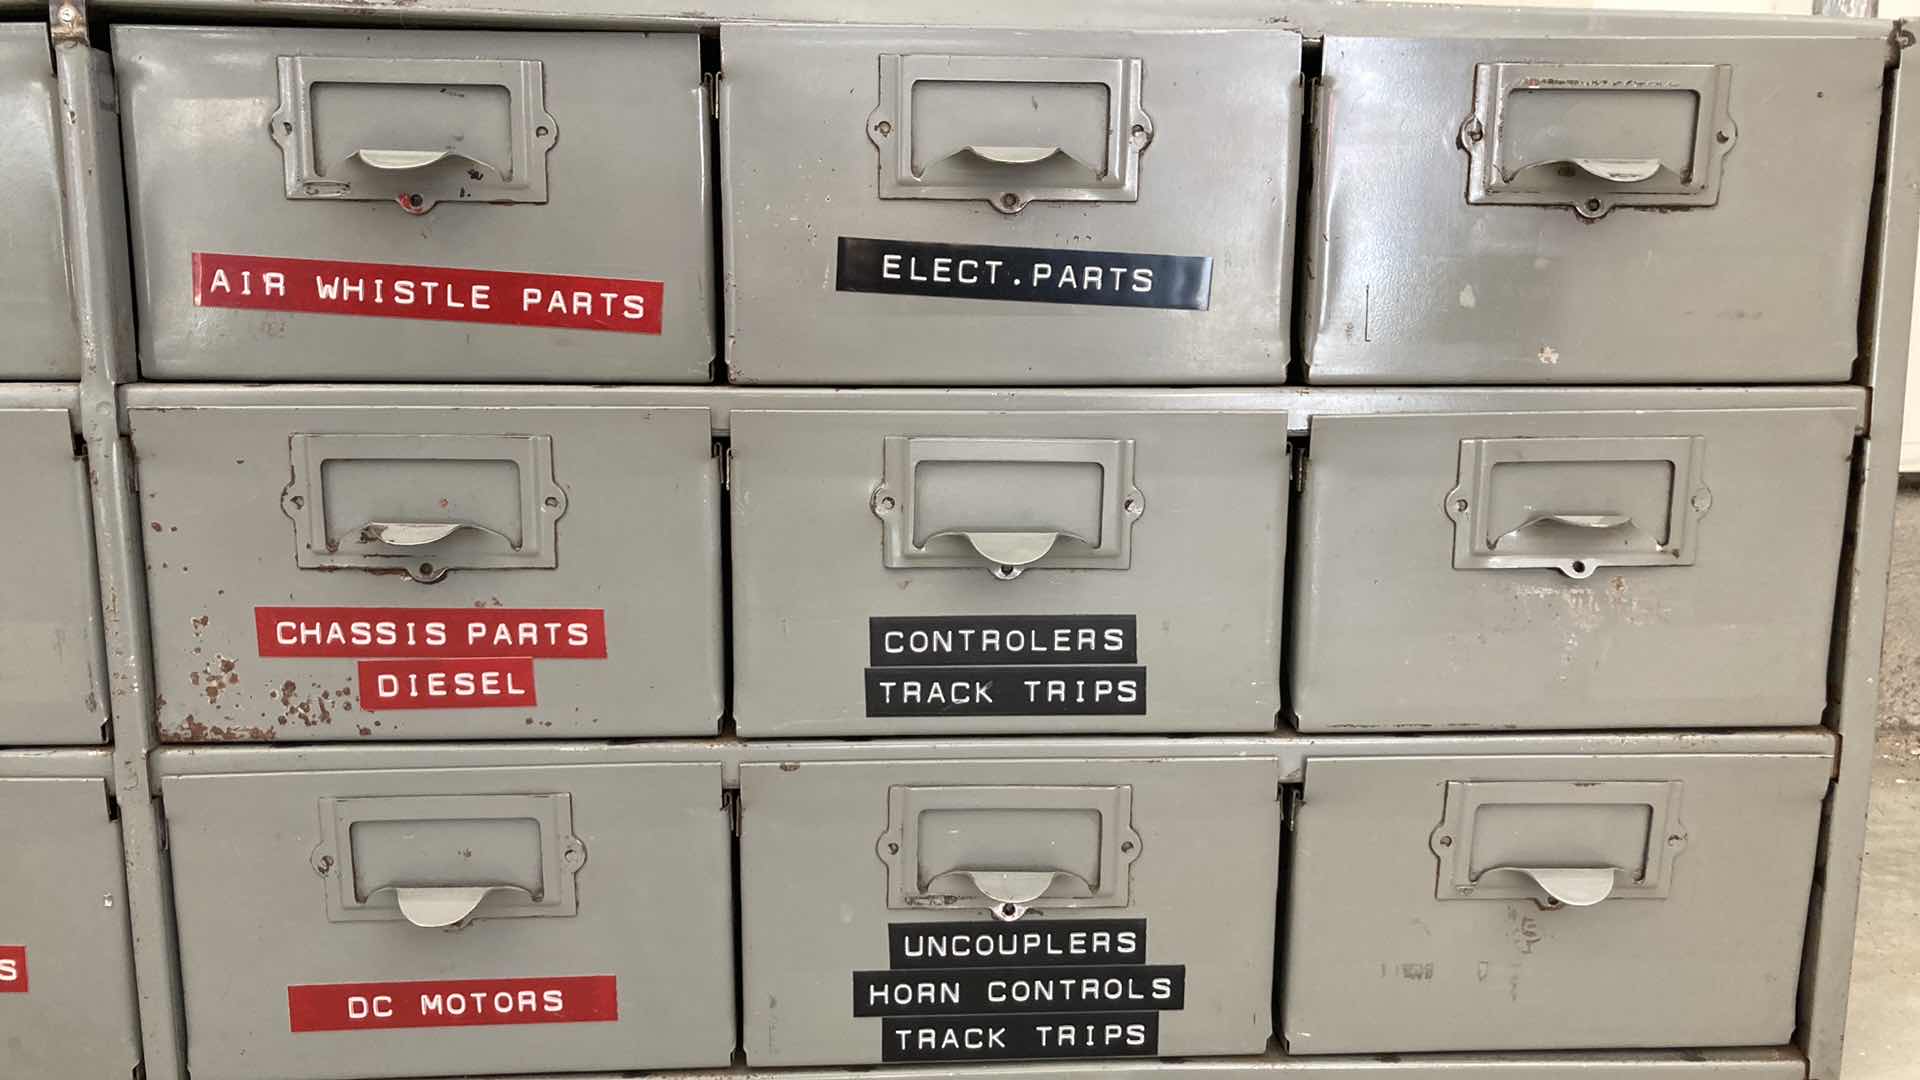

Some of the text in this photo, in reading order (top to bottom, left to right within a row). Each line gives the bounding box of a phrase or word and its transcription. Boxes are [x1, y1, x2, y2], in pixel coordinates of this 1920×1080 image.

[210, 268, 646, 319] AIR WHISTLE PARTS
[276, 622, 589, 646] CHASSIS PARTS
[884, 629, 1125, 655] CONTROLERS
[377, 671, 526, 698] DIESEL
[879, 680, 1138, 705] TRACK TRIPS
[904, 931, 1138, 957] UNCOUPLERS
[348, 990, 564, 1019] DC MOTORS
[869, 977, 1171, 1006] HORN CONTROLS
[895, 1025, 1145, 1051] TRACK TRIPS
